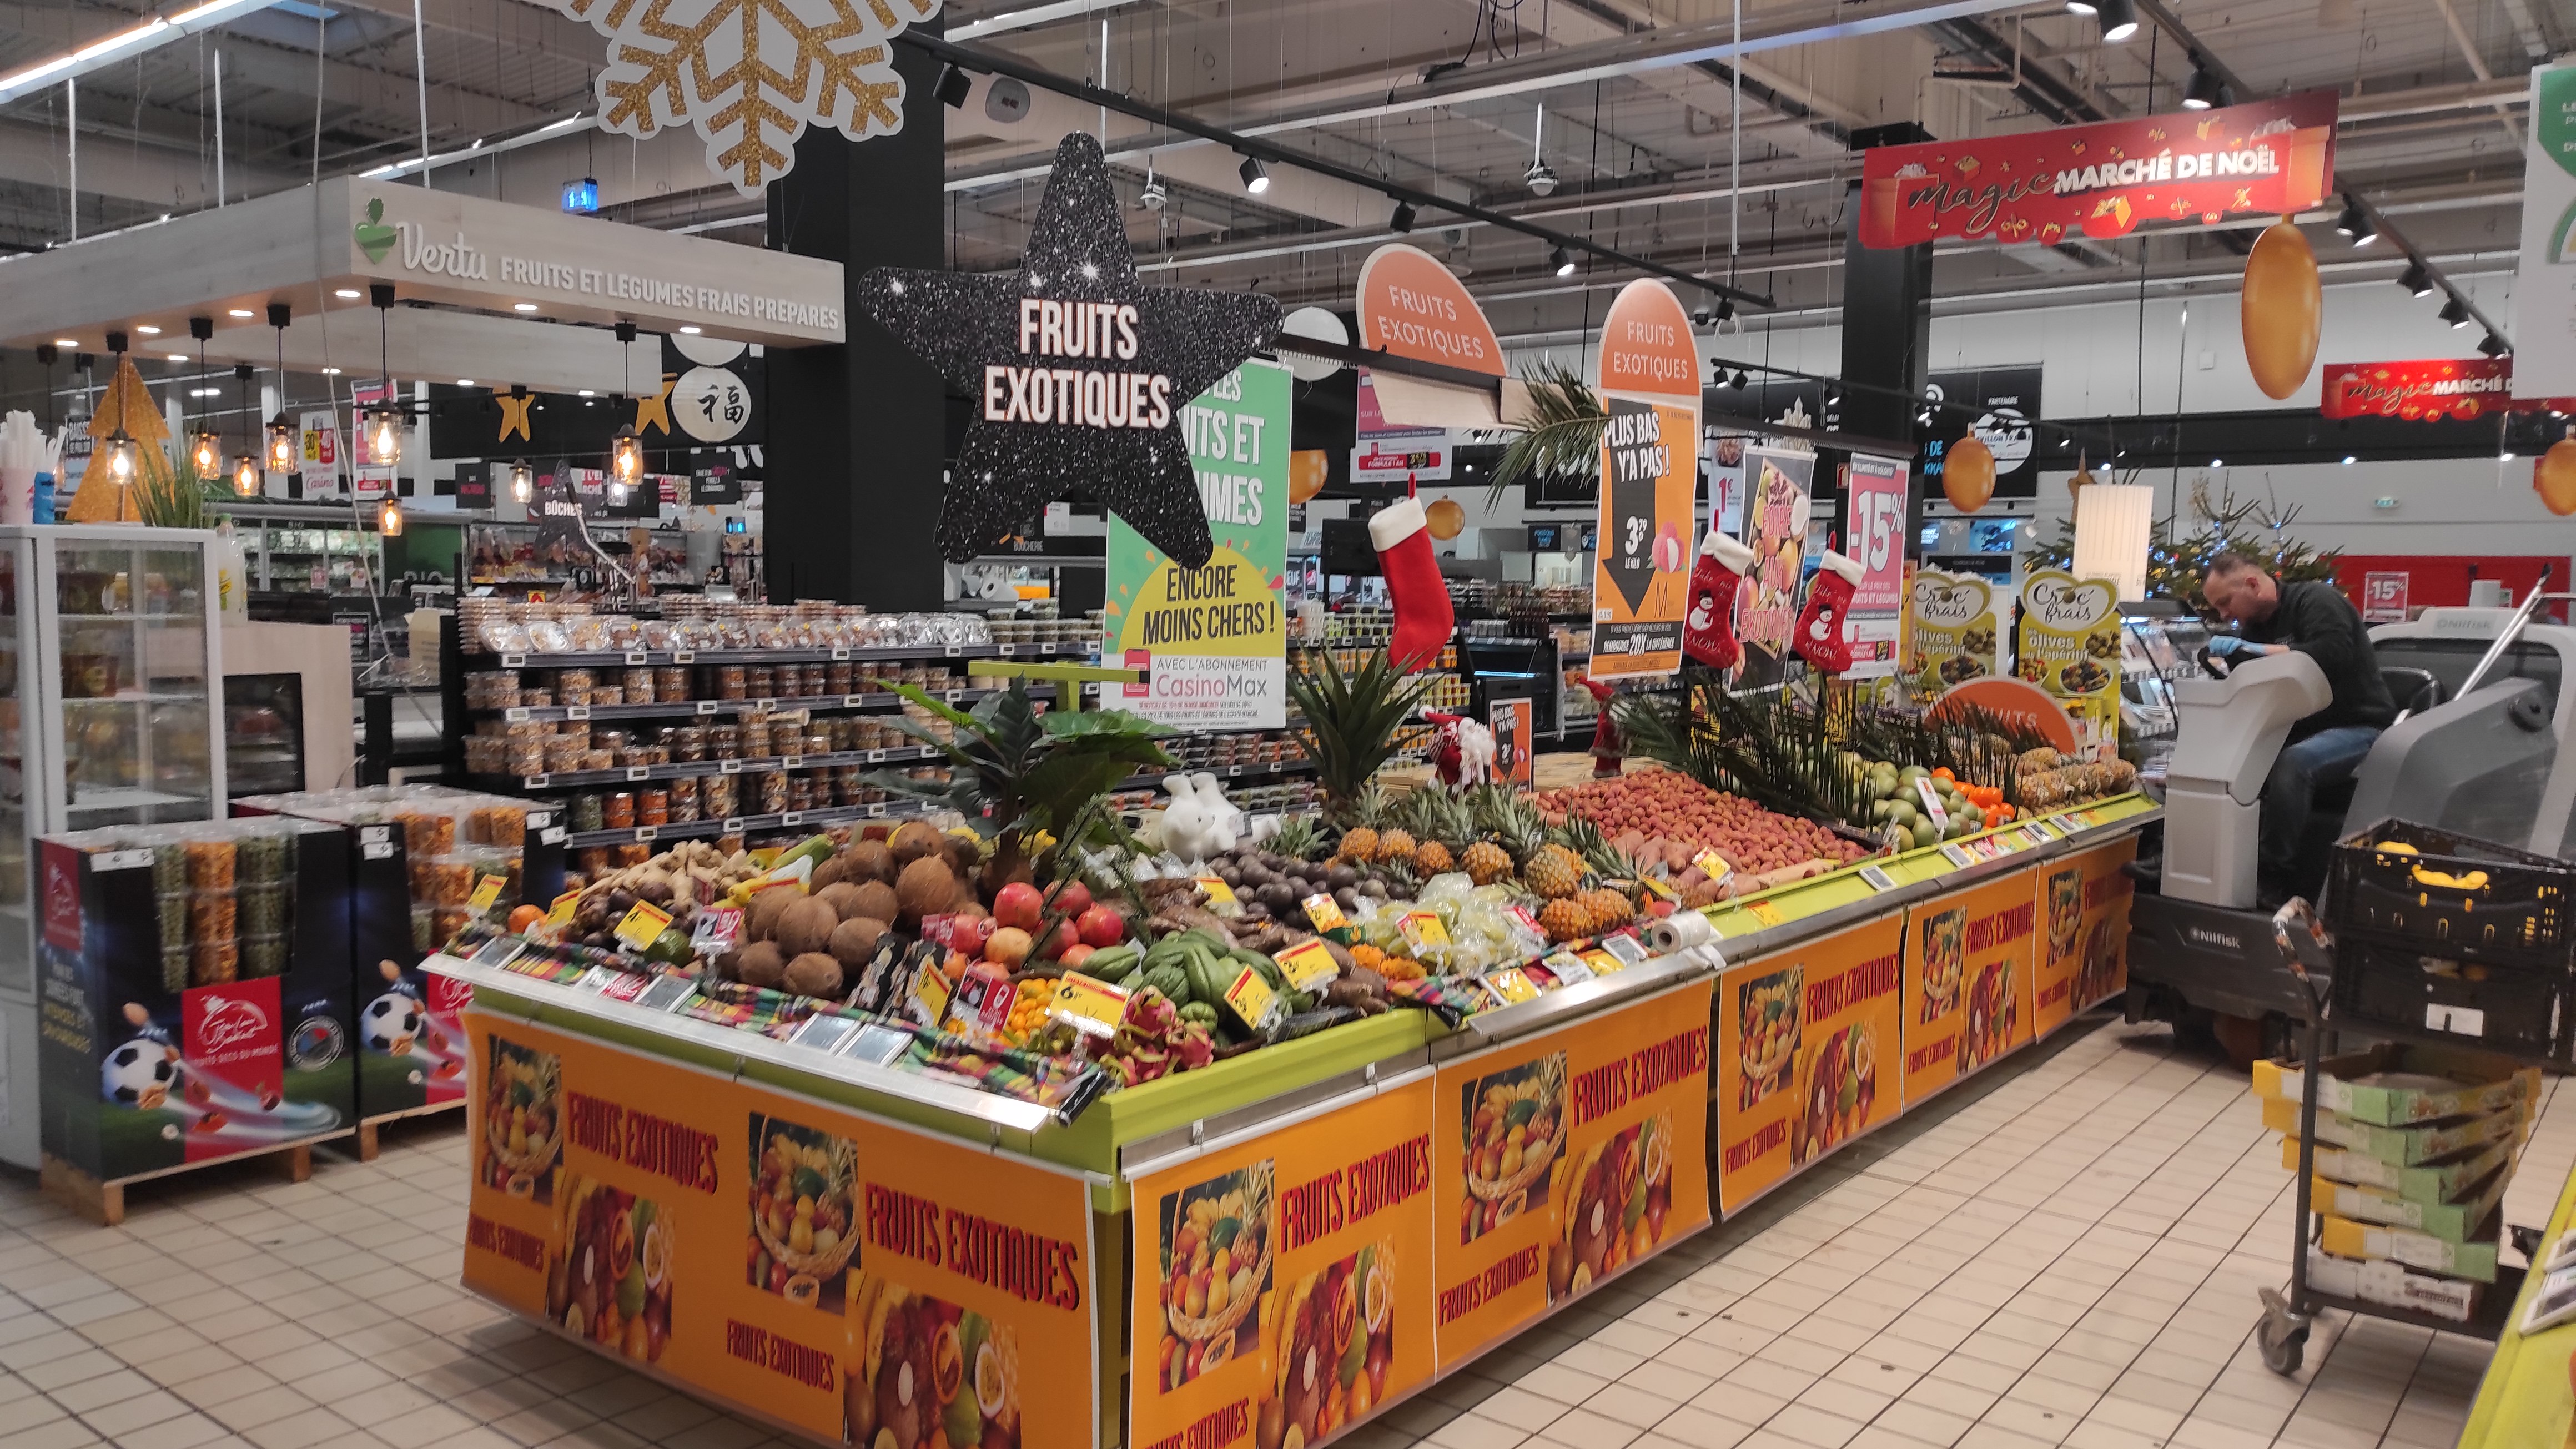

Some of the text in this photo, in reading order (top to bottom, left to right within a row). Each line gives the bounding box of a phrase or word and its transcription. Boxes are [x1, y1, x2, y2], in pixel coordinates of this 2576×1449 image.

[2054, 148, 2172, 195] MARCHÉ
[2177, 154, 2213, 178] DE
[2217, 144, 2280, 176] NOËL
[396, 222, 489, 281] Vertu
[501, 256, 574, 290] FRUITS
[579, 268, 603, 295] ET
[696, 288, 751, 316] FRAIS
[1387, 285, 1457, 323] FRUITS
[1019, 298, 1138, 361] FRUITS
[1377, 316, 1485, 359] EXOTIQUES
[1627, 320, 1674, 347] FRUITS
[1213, 369, 1242, 402] LES
[1613, 351, 1688, 382] EXOTIQUES
[984, 364, 1171, 429] EXOTIQUES
[1233, 413, 1265, 465] ET
[1603, 411, 1661, 449] PLUS BAS
[1617, 449, 1638, 484] Y'A
[1639, 445, 1663, 480] PAS
[1761, 504, 1793, 539] FOIRE
[1166, 564, 1238, 603] ENCORE
[1763, 555, 1785, 590] AUX
[1141, 606, 1204, 647] MOINS
[1207, 601, 1266, 640] CHERS
[1739, 608, 1793, 643] EXOTIQUES
[2044, 604, 2092, 624] frais
[1156, 657, 1269, 672] AVEC L'ABONNEMENT
[1628, 632, 1648, 656] 20X
[1155, 673, 1267, 698] CasinoMax
[1965, 911, 1995, 957] FRUITS
[2201, 929, 2241, 949] Nilfisk
[1805, 973, 1844, 1026] FRUITS
[1572, 1024, 1707, 1129] FRUITS EXOTIQUES
[567, 1089, 719, 1196] FRUITS EXOTIQUES
[1724, 1116, 1787, 1176] FRUITS EXOTIQUES
[1280, 1131, 1431, 1255] FRUITS EXOTIQUES
[865, 1181, 1080, 1312] FRUITS EXOTIQUES
[1438, 1242, 1540, 1327] FRUITS EXOTIQUES
[726, 1317, 835, 1394] FRUITS EXOTIQUES
